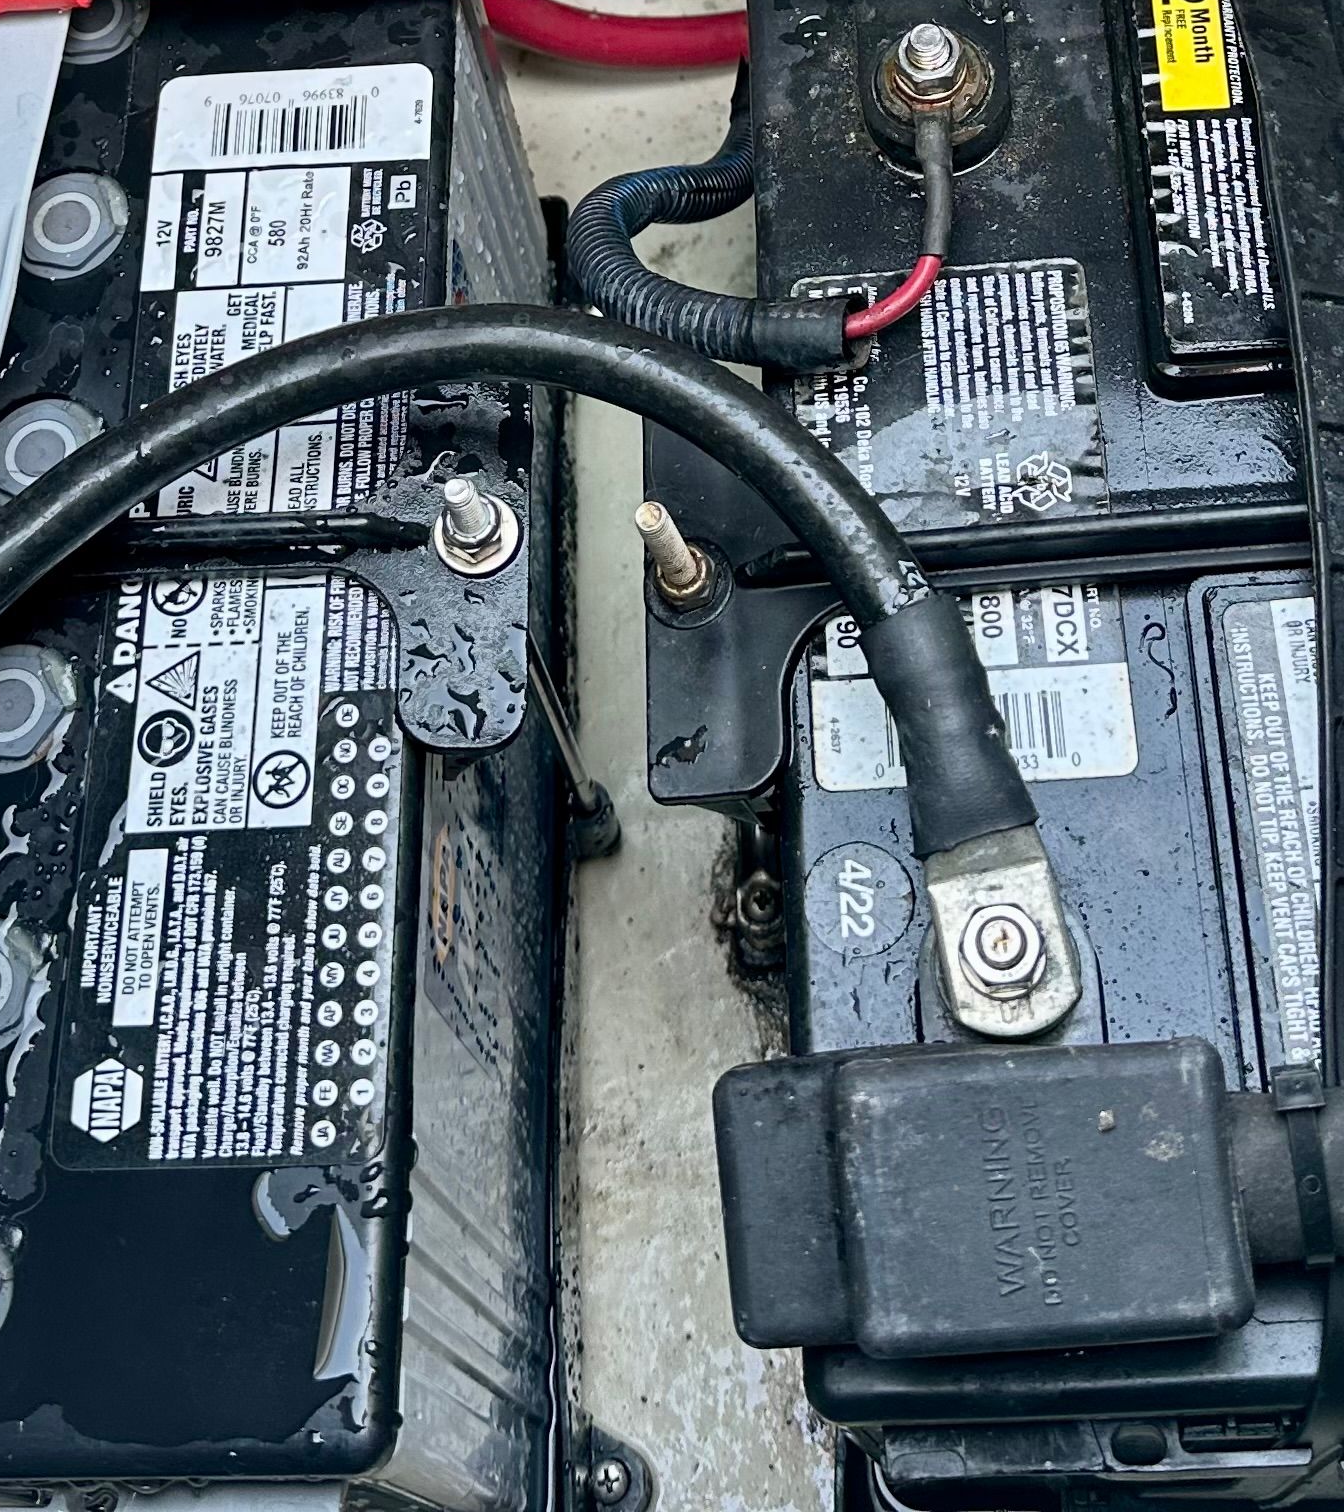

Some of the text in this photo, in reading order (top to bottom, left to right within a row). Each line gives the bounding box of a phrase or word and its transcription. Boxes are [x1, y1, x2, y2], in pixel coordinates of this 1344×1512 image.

[1188, 8, 1215, 62] Month
[239, 88, 344, 104] 83996 07076
[395, 180, 411, 202] Pb
[1176, 118, 1202, 239] FOR MORE INFORMATION
[155, 220, 172, 246] 12V
[183, 226, 197, 252] PART
[204, 201, 226, 257] 9827M
[267, 220, 286, 246] 580
[296, 171, 314, 269] 92Ah 20Hr Rate
[247, 240, 258, 263] CCA
[226, 293, 242, 316] GET
[241, 292, 258, 349] MEDICAL
[260, 291, 276, 325] FAST.
[1047, 269, 1068, 339] PROPOSITION
[175, 333, 191, 365] EYES
[832, 385, 851, 422] 19536
[1054, 352, 1075, 410] WARNING:
[339, 421, 355, 456] DO NOT
[357, 409, 374, 446] PROPER
[854, 404, 871, 427] 102
[246, 448, 262, 486] BURNS.
[289, 462, 303, 482] ALL
[978, 457, 996, 510] BATTERY
[995, 453, 1013, 513] LEAD ACID
[171, 618, 187, 638] NO
[327, 595, 344, 636] RISK OF
[343, 586, 364, 691] NOT RECOMMENDED
[978, 595, 1002, 638] 800
[269, 632, 291, 739] KEEP OUT OF THE
[285, 605, 310, 737] REACH OF CHILDREN.
[191, 685, 219, 824] EXPLOSIVE GASES
[212, 679, 237, 824] CAN CAUSE BLINDNESS
[1257, 673, 1303, 862] KEEP OUT OF THE REACH
[146, 771, 167, 827] SHIELD
[169, 782, 188, 825] EYES.
[228, 805, 243, 823] OR
[316, 707, 353, 1141] JA FE MA AP MY JU JY SE OC DE
[839, 859, 875, 938] 4/22
[1249, 755, 1308, 1042] DO NOT TIP. KEEP VENT CAPS TIGHT
[79, 904, 103, 986] IMPORTANT
[96, 876, 124, 1003] NONSERVICEABLE
[121, 880, 144, 994] DO NOT ATTEMPT
[138, 883, 160, 990] TO OPEN VENTS.
[358, 818, 383, 1055] 2 3 4 5 6 7 8
[207, 1033, 225, 1074] Do NOT
[90, 1070, 124, 1125] NAPA
[978, 1106, 1026, 1297] WARNING
[1055, 1156, 1081, 1247] COVER
[1041, 1269, 1063, 1305] DO
